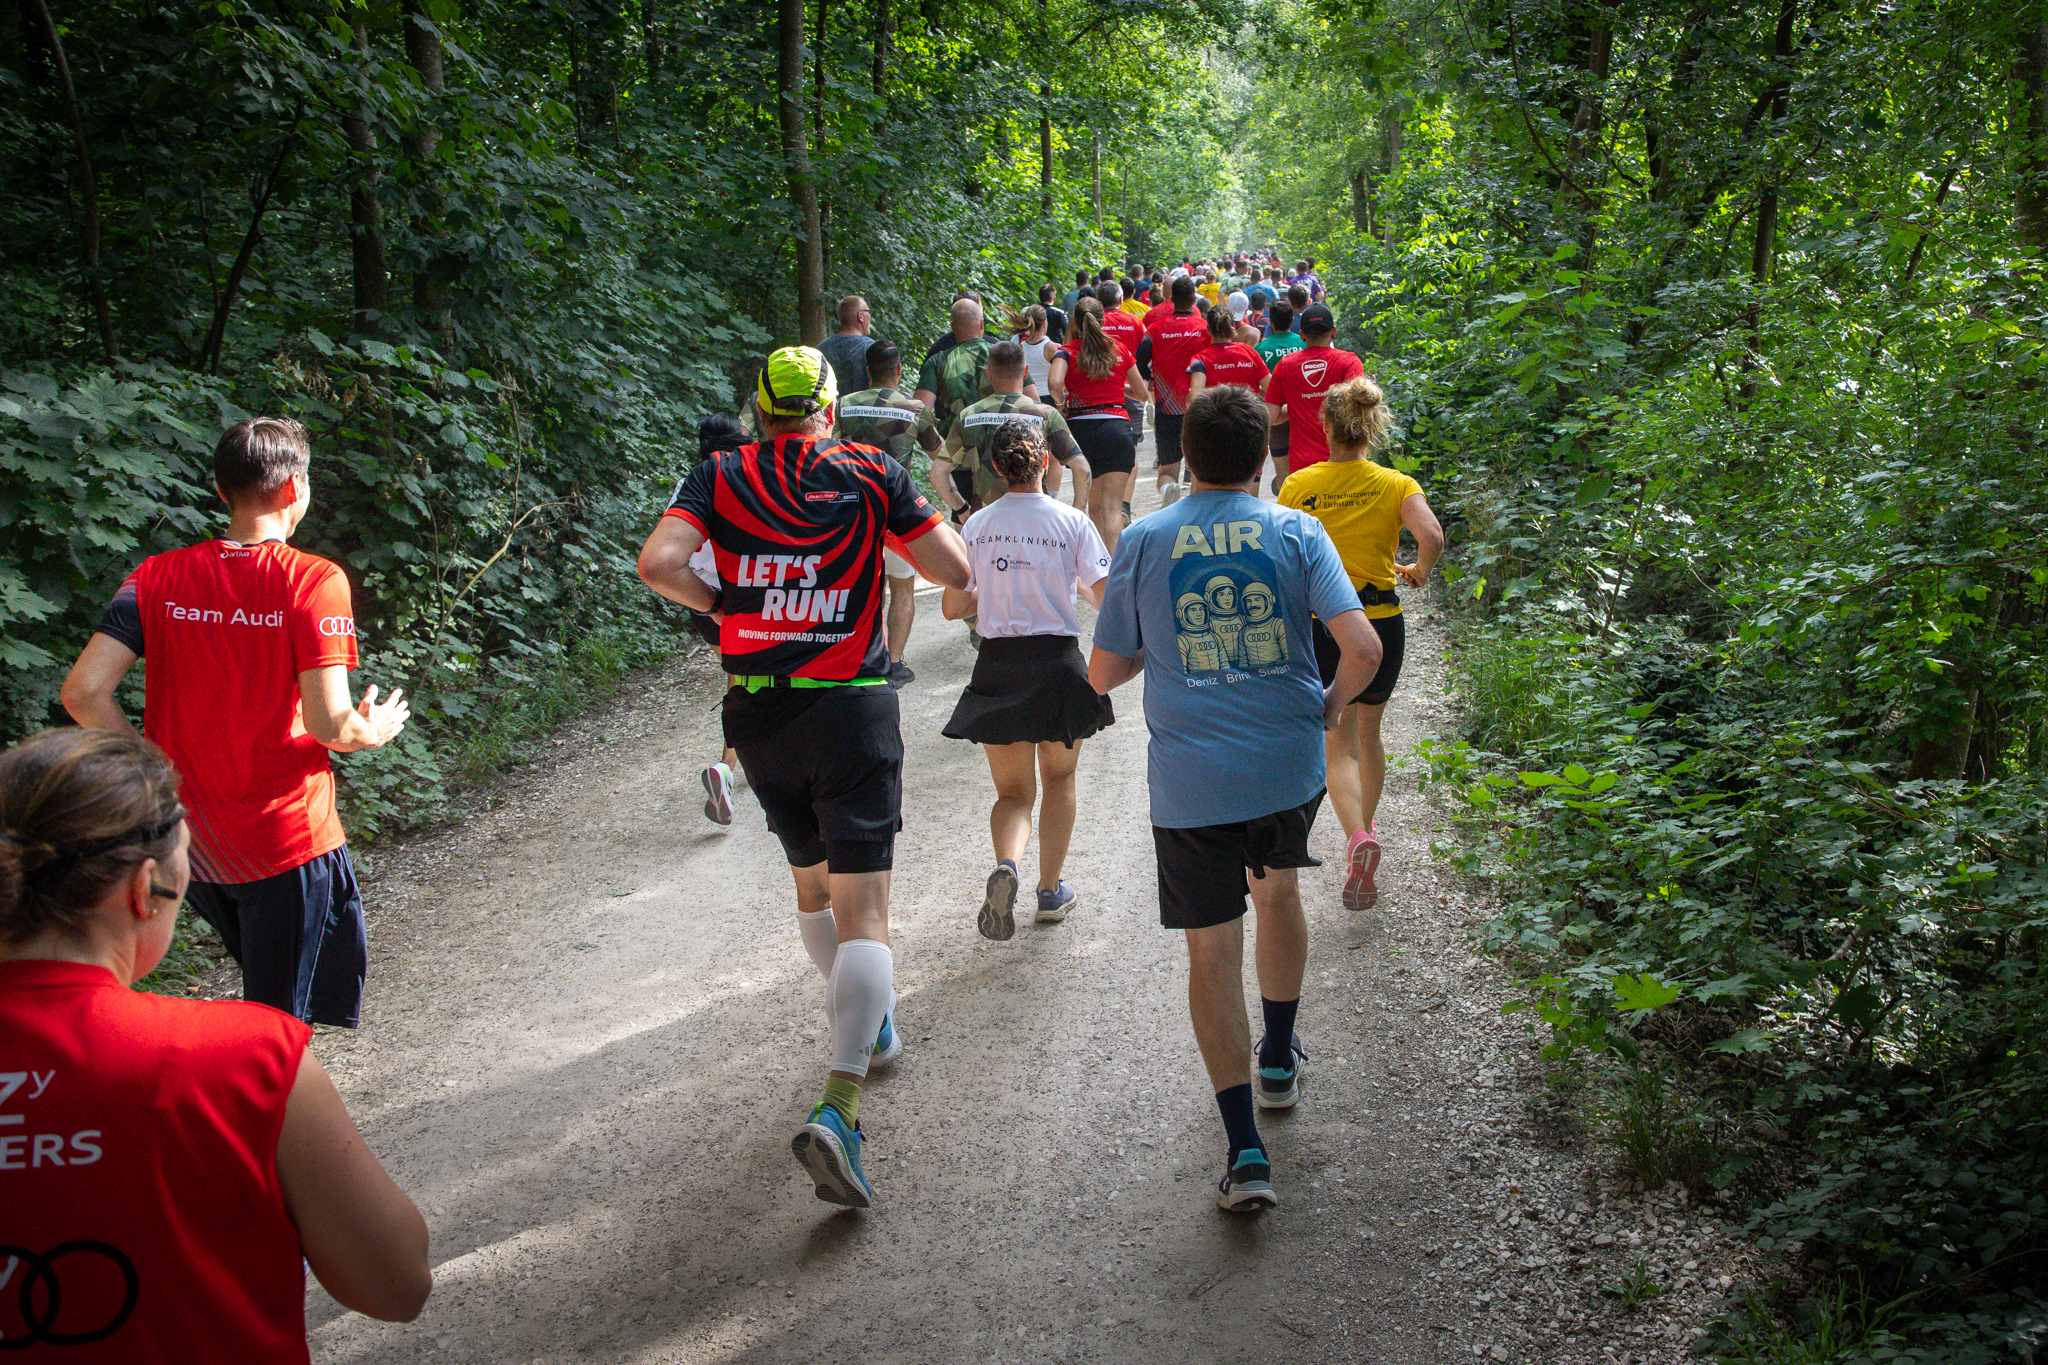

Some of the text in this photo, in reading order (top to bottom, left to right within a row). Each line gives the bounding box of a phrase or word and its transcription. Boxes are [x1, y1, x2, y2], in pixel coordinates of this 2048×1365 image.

[842, 408, 913, 420] bundeswehrkarriere.de
[1323, 490, 1381, 500] Tierschutzverein
[1170, 520, 1265, 560] AIR
[761, 589, 850, 623] RUN!
[165, 602, 284, 627] Team Audi
[738, 629, 856, 643] MOVING FORWARD TOGETH
[1187, 676, 1219, 688] Deniz
